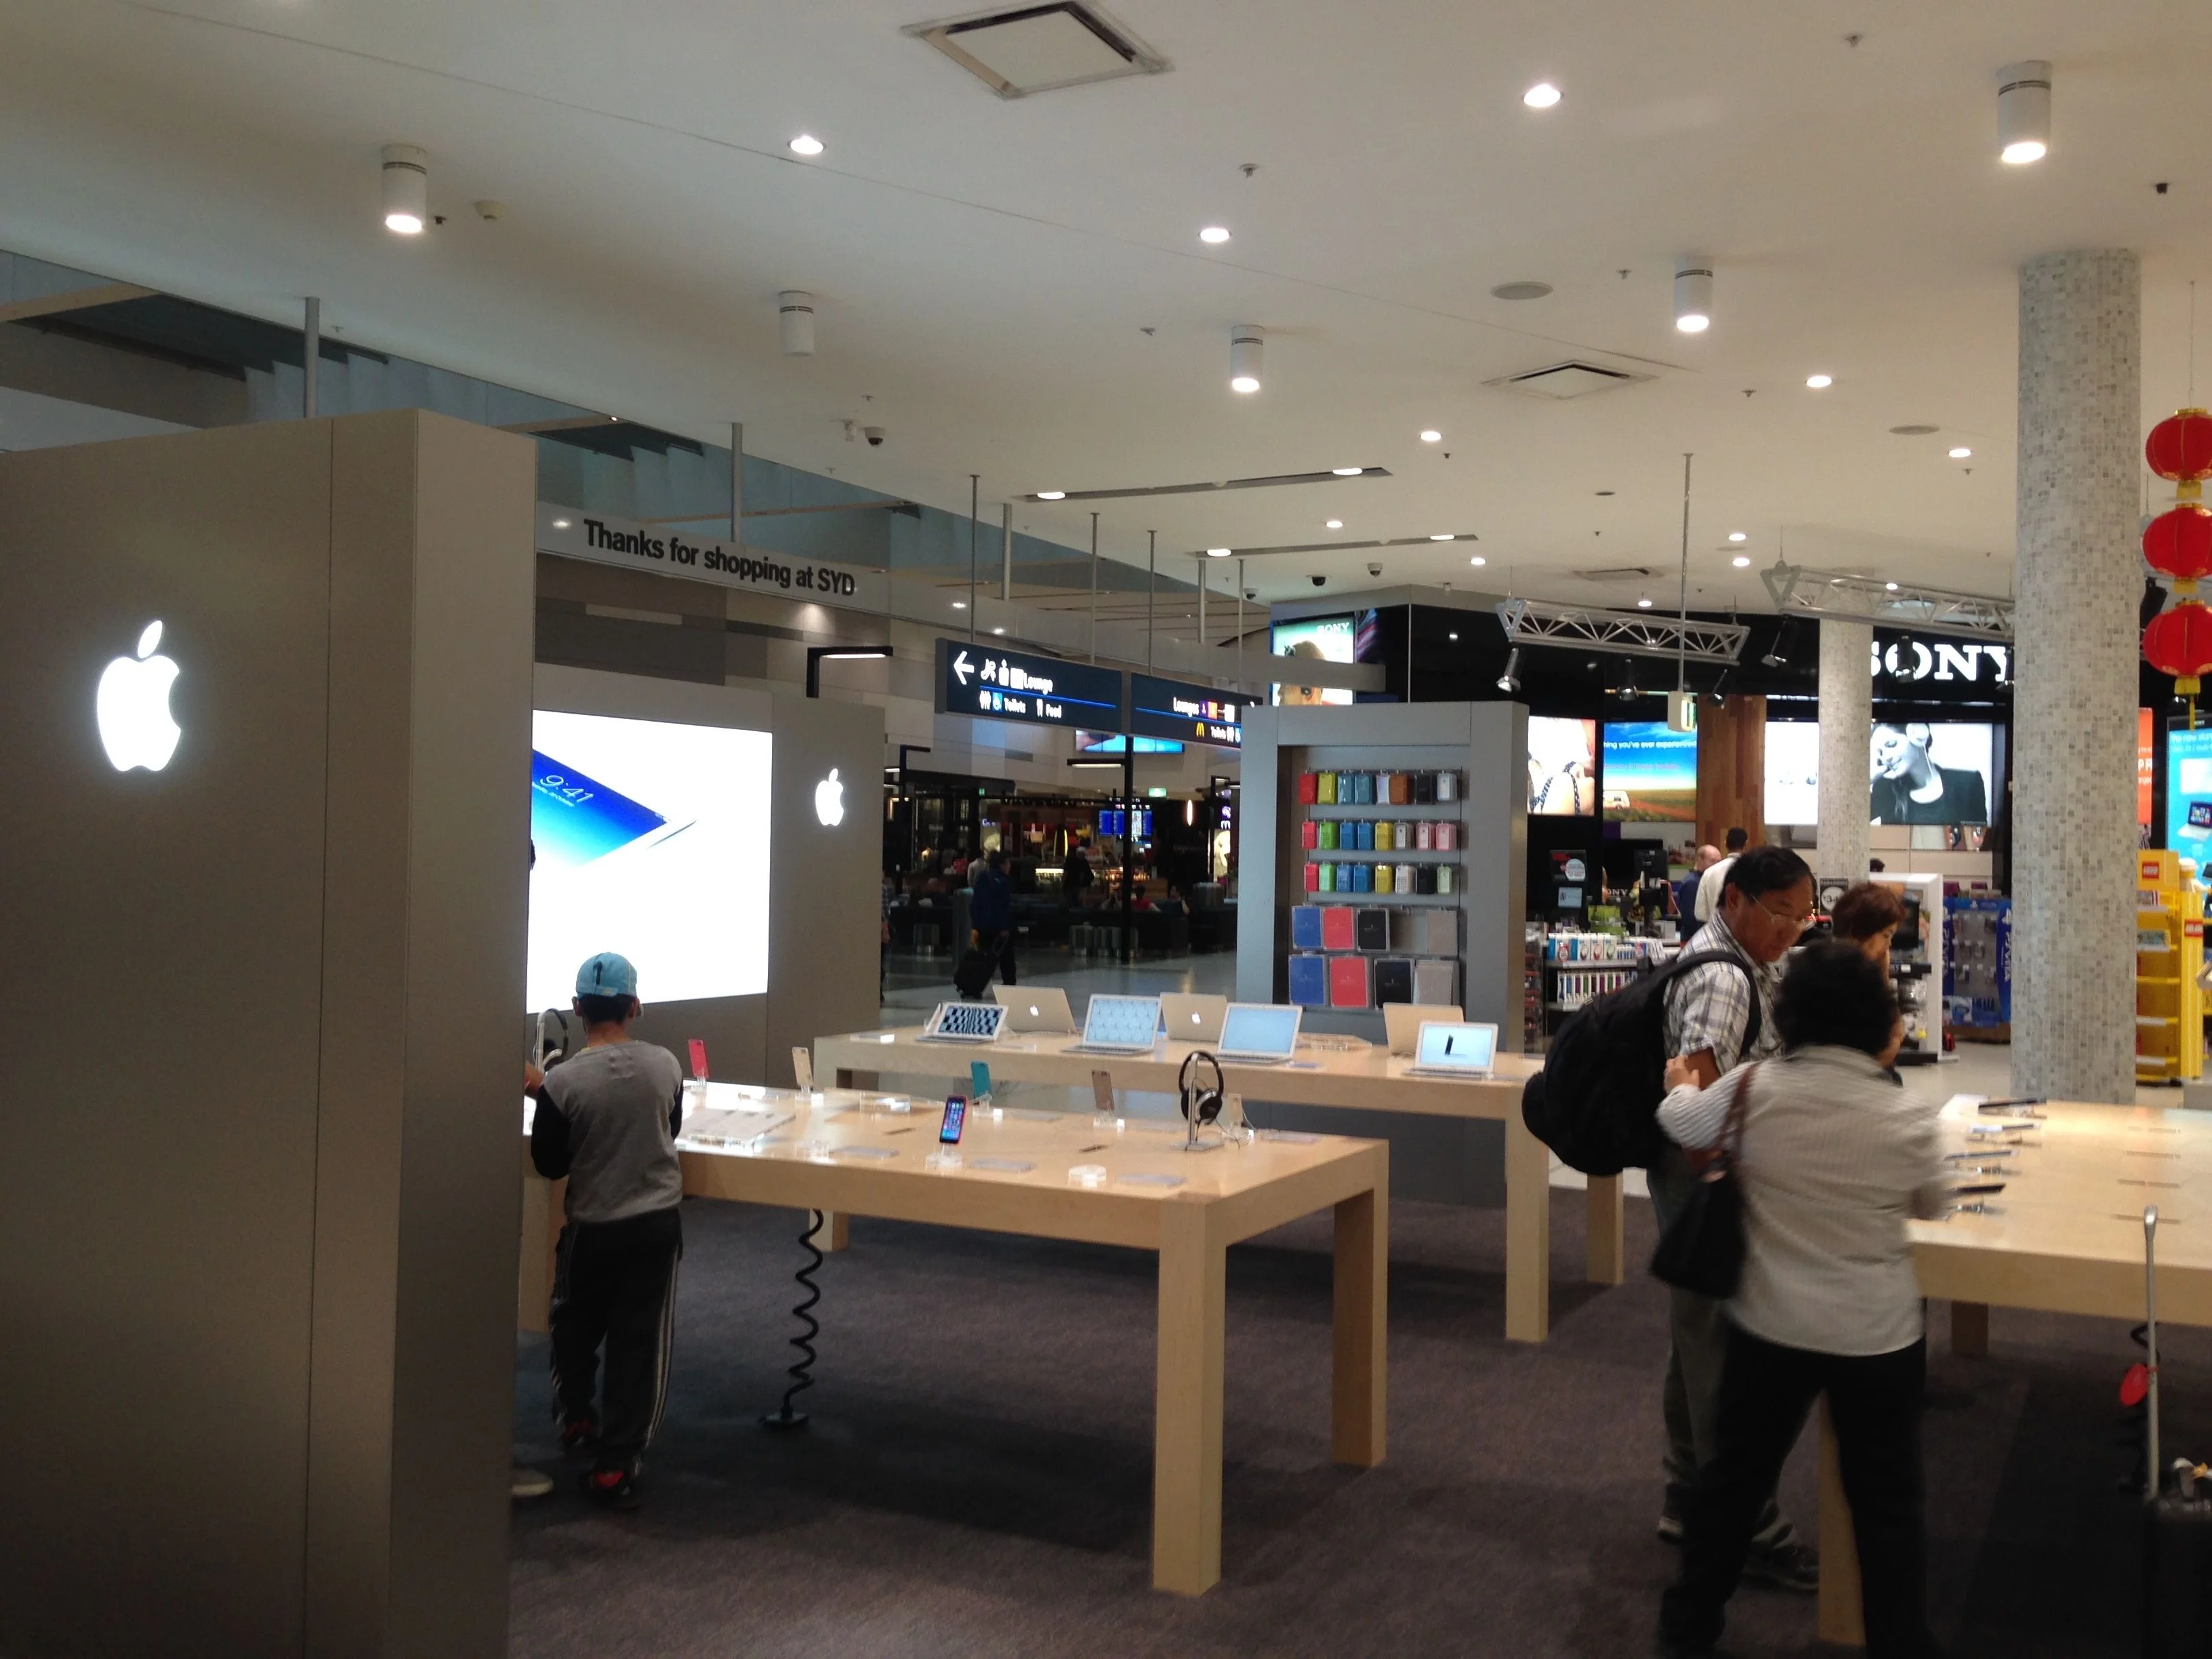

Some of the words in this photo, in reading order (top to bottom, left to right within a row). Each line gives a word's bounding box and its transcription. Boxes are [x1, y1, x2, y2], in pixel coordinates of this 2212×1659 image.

[583, 518, 664, 559] Thanks
[670, 537, 699, 566] for
[704, 546, 791, 588] shopping
[796, 566, 814, 589] at
[817, 568, 855, 596] SYD
[1870, 641, 2009, 682] ONY
[1024, 672, 1053, 695] Lounge
[1004, 697, 1026, 714] Toilets
[1046, 703, 1062, 718] Food
[1173, 697, 1200, 718] Lounges
